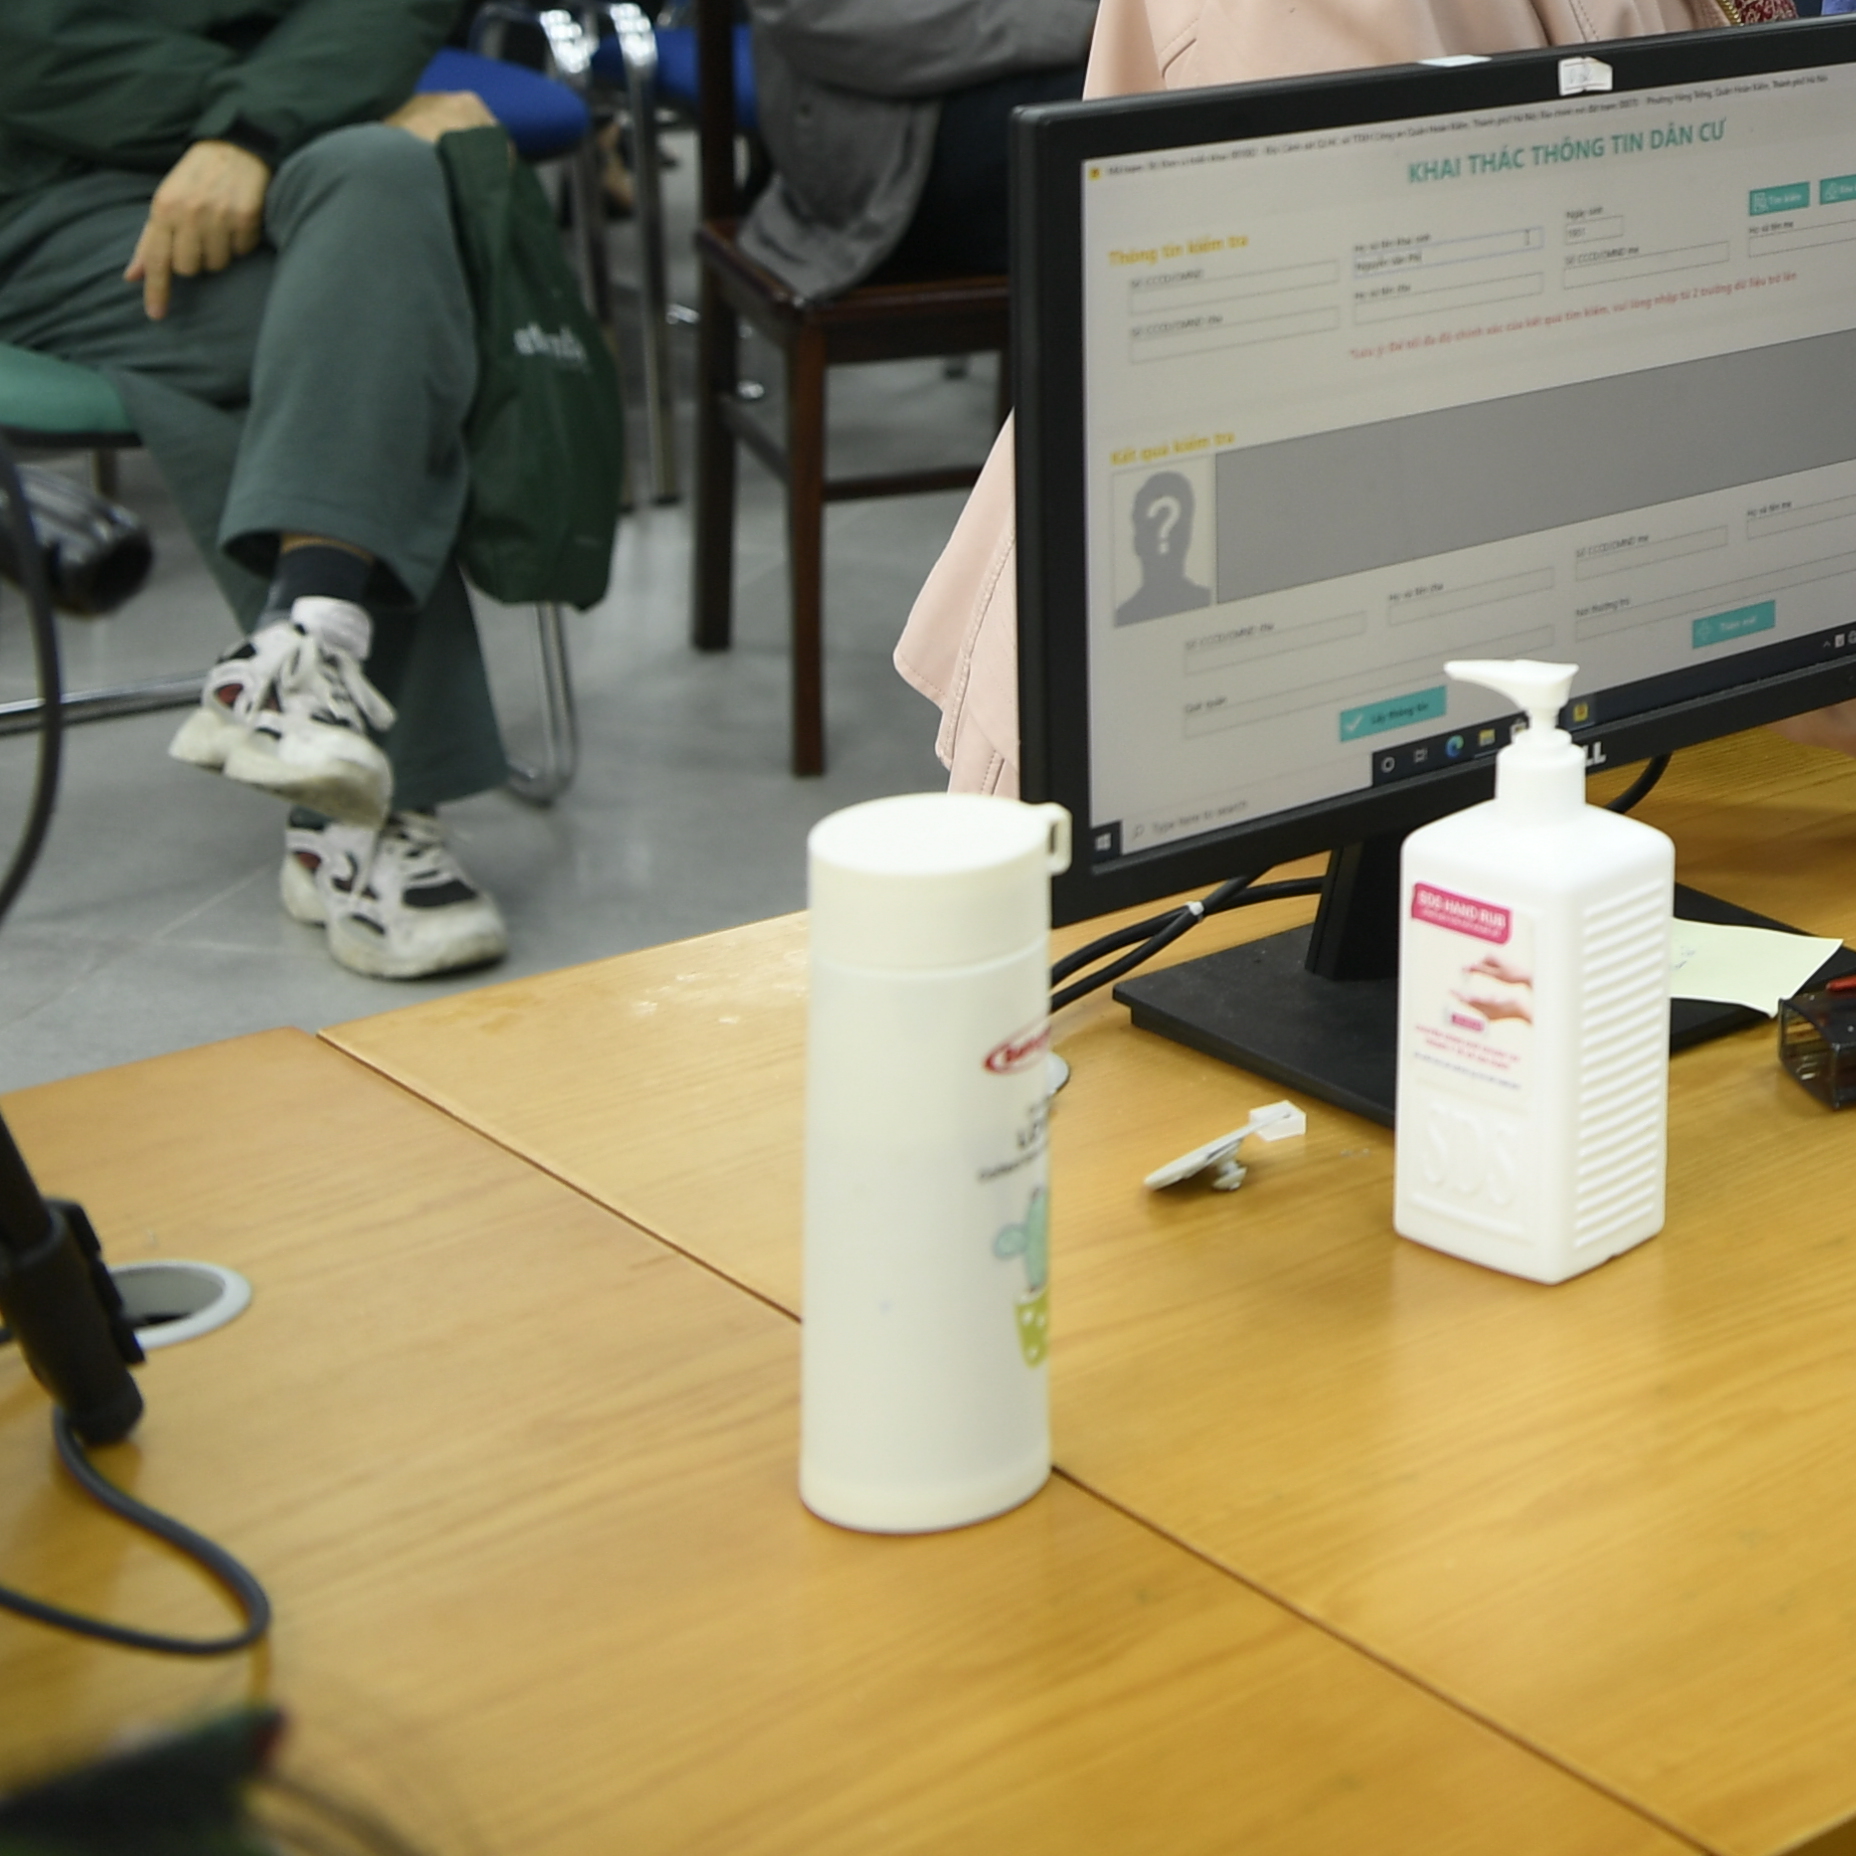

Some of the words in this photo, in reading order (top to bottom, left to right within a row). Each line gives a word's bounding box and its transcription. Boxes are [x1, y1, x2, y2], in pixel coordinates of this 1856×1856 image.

[1407, 155, 1460, 185] KHAI
[1467, 141, 1525, 176] THÁC
[1530, 130, 1605, 167] THÔNG
[1611, 130, 1643, 156] TIN
[1650, 118, 1694, 150] DÂN
[1698, 116, 1726, 143] CƯ
